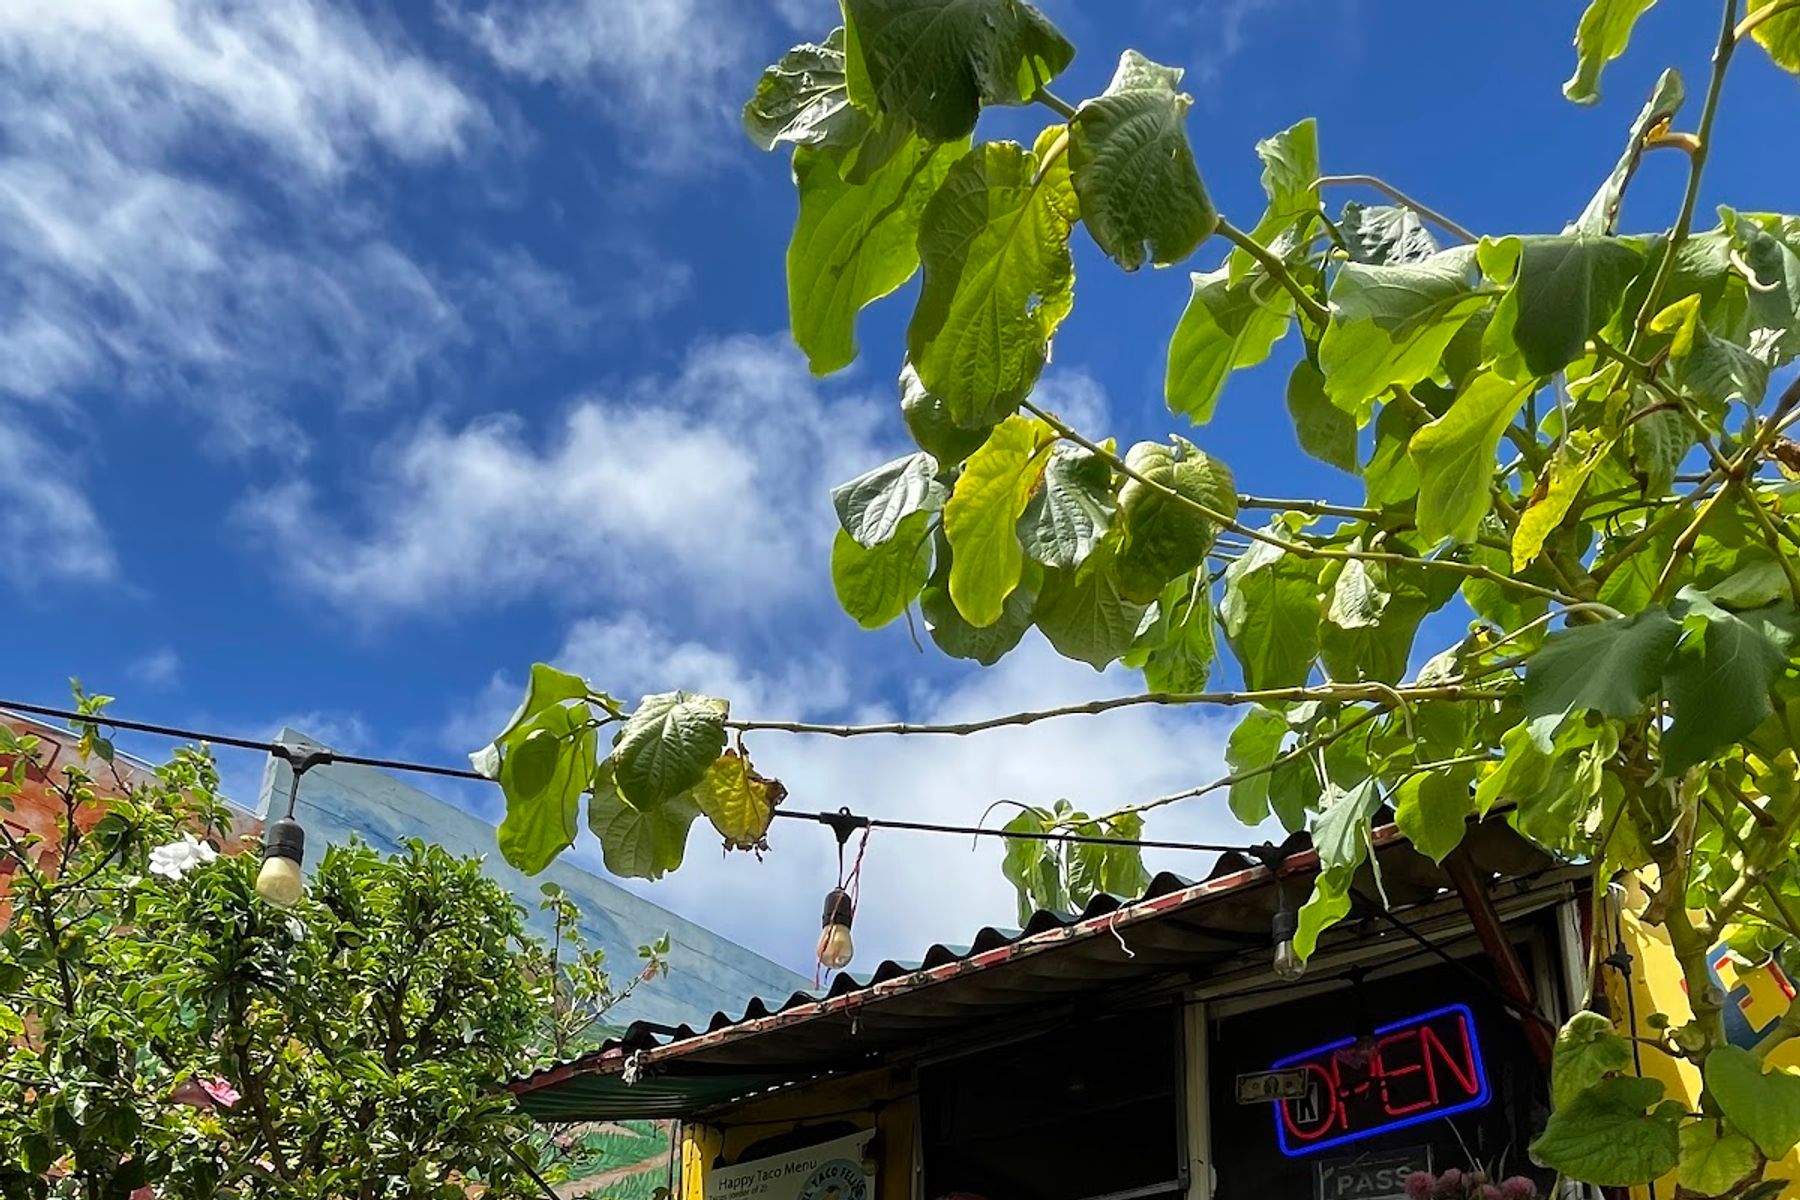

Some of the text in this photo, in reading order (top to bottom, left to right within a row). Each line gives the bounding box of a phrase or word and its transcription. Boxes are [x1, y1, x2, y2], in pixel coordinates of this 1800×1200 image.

[1282, 1015, 1479, 1140] OPEN
[718, 1159, 818, 1191] Happy Taco Menu
[811, 1166, 839, 1188] TACO
[1337, 1166, 1413, 1196] PASS
